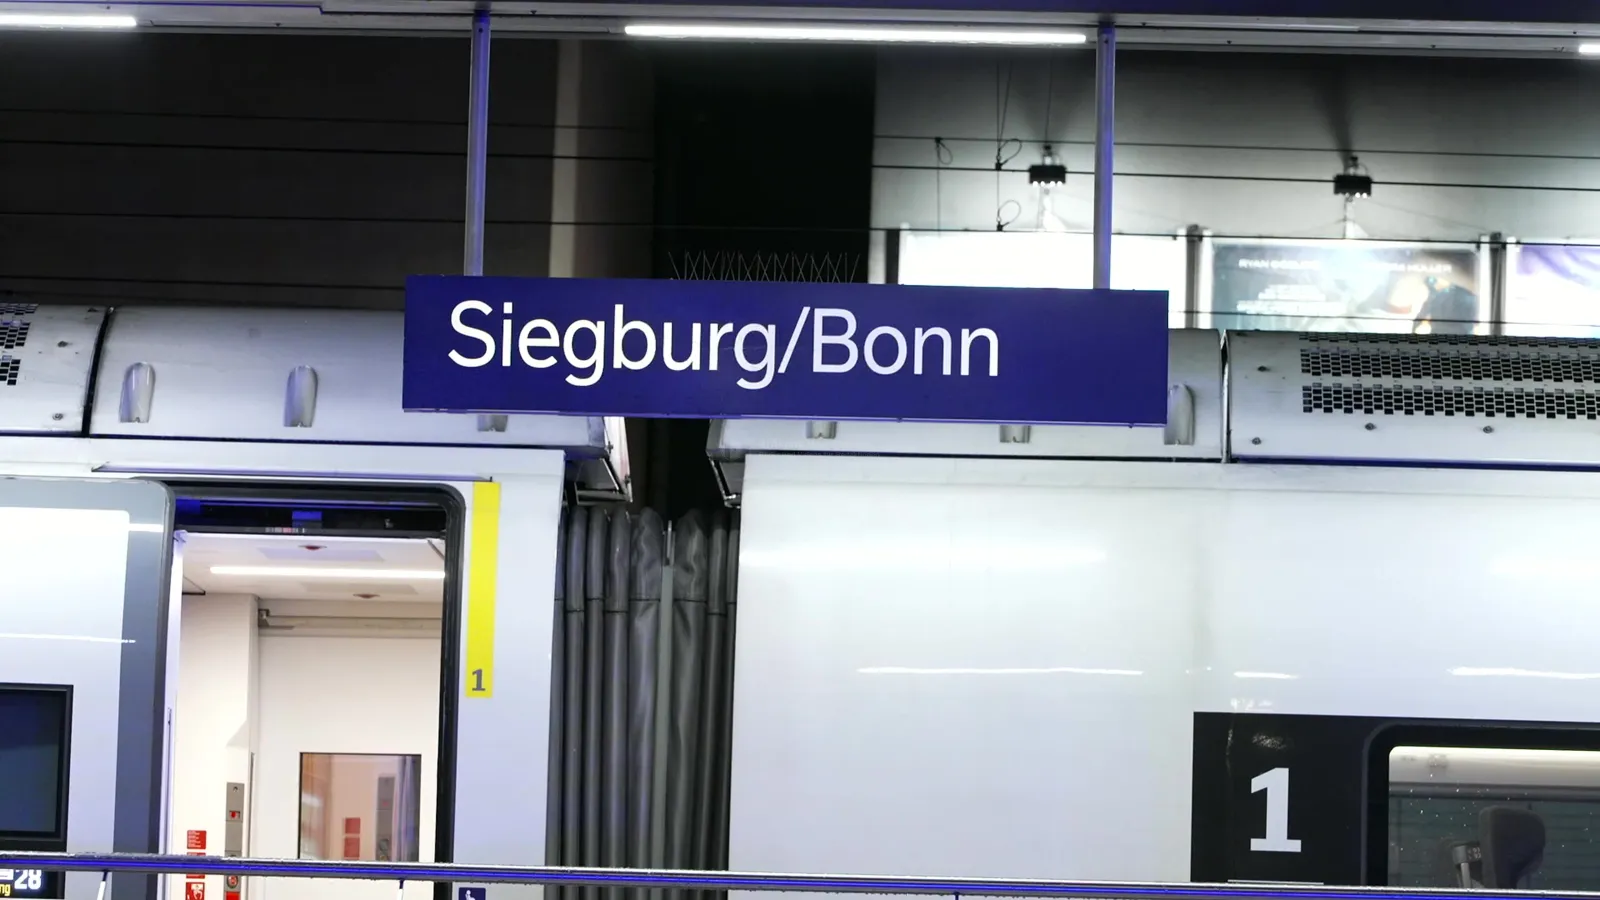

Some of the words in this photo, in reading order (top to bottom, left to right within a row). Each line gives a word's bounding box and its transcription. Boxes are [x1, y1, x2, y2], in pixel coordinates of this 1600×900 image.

[448, 299, 1000, 390] Siegburg/Bonn
[472, 668, 486, 691] 1
[1250, 767, 1302, 853] 1
[14, 868, 42, 890] 28
